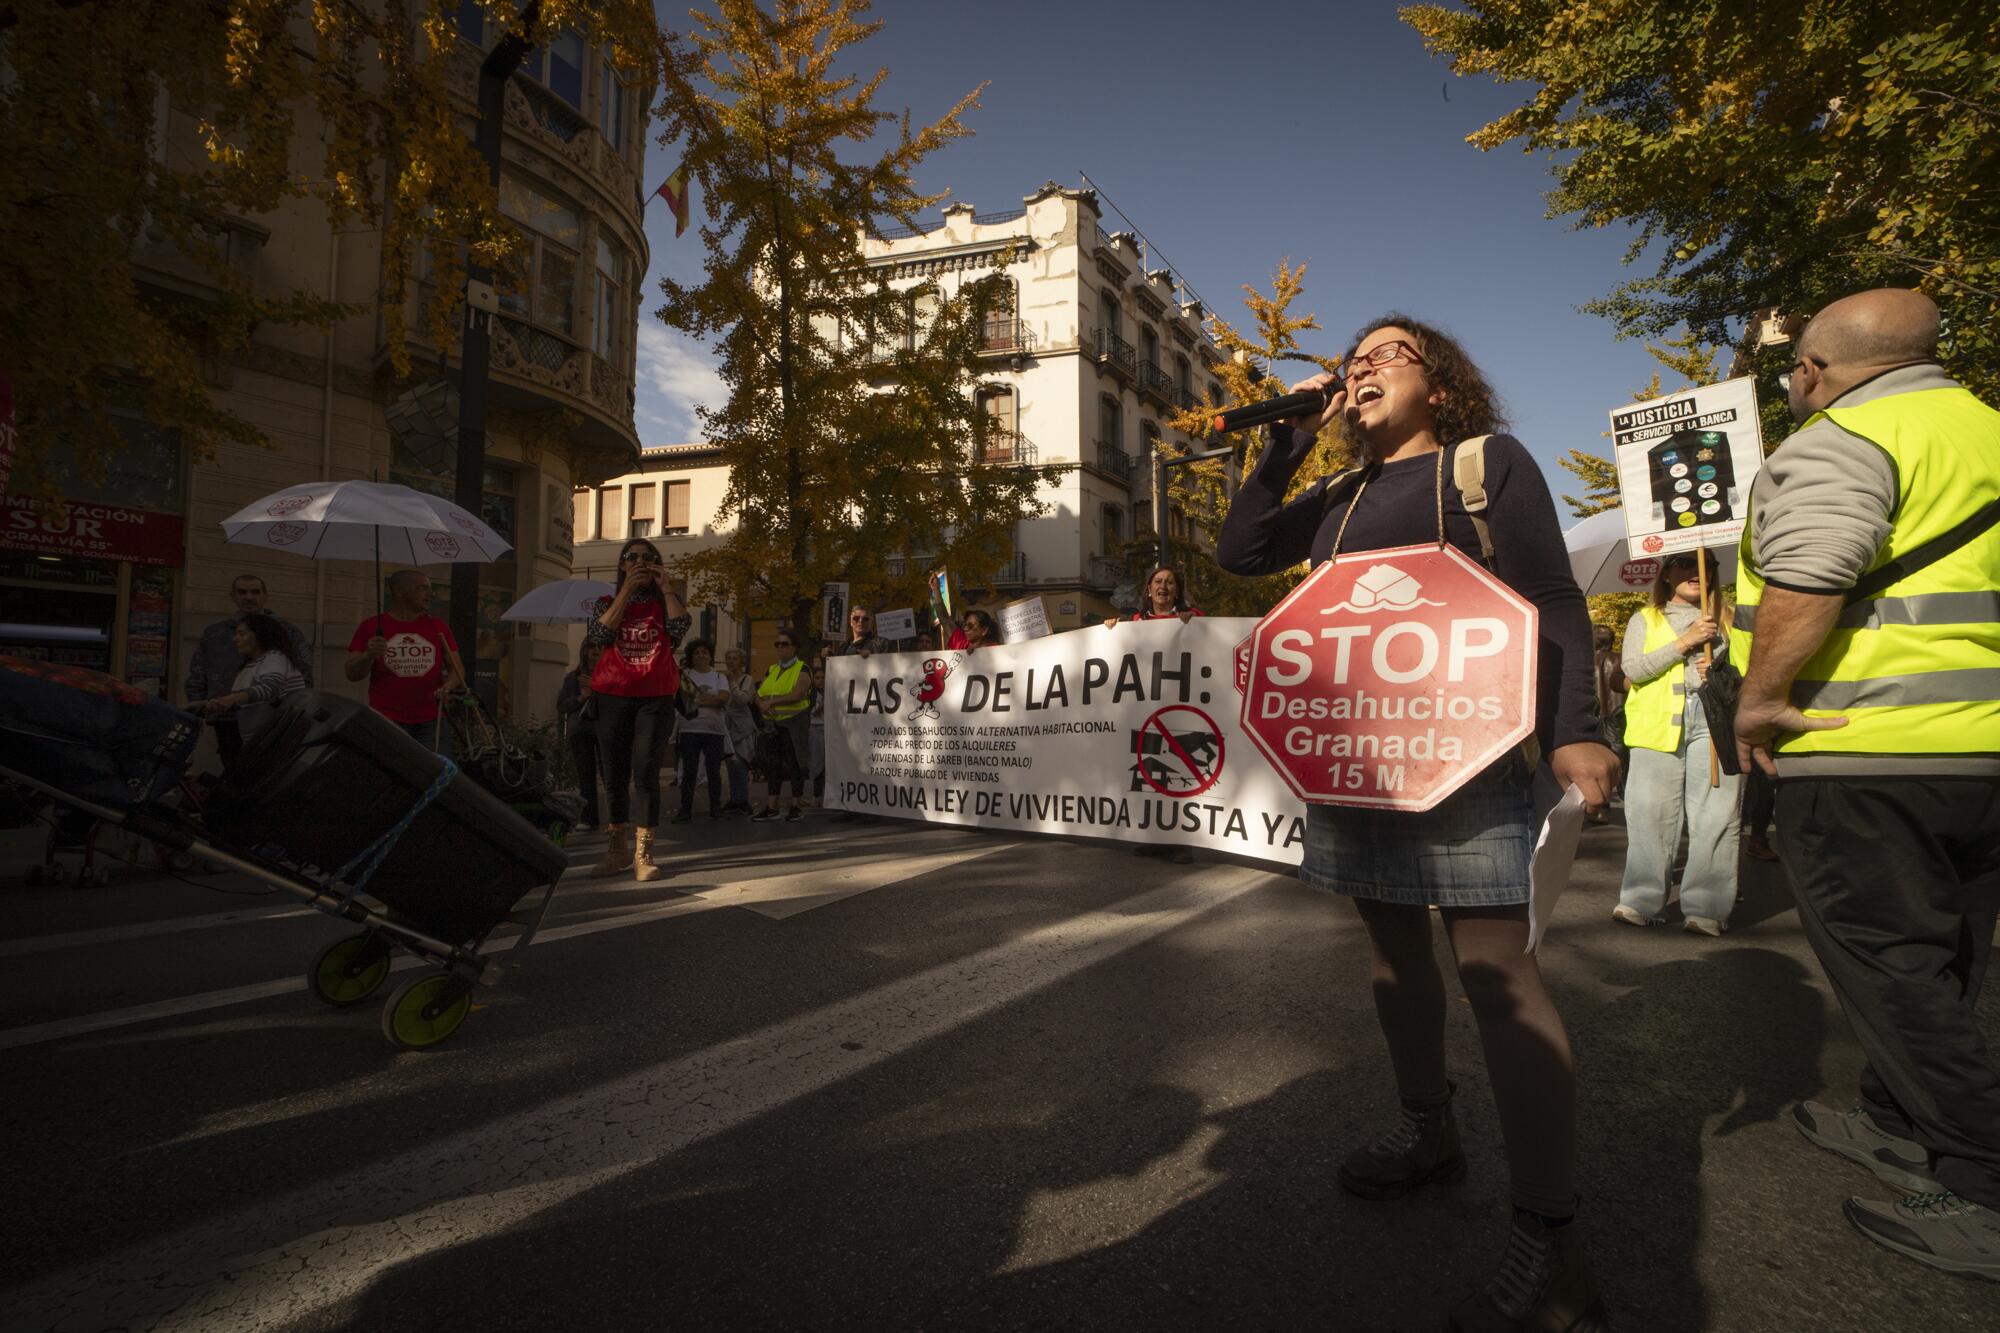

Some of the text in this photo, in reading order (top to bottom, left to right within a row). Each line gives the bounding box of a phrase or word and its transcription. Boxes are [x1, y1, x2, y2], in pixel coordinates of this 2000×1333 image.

[1619, 400, 1693, 427] LA JUSTICIA
[1622, 410, 1734, 444] AL SERVICIO DE LA BANCA
[9, 510, 104, 538] SUR
[58, 534, 86, 548] VÍA
[620, 628, 658, 642] STOP
[387, 646, 432, 658] STOP
[1266, 617, 1510, 686] STOP
[847, 678, 903, 714] LAS
[960, 671, 1014, 713] DE
[1026, 664, 1068, 710] LA
[1082, 652, 1212, 705] PAH:
[1261, 688, 1503, 721] Desahucios
[887, 726, 893, 736] A
[894, 726, 907, 736] LOS
[908, 726, 958, 736] DESAHUCIOS
[959, 726, 974, 736] SIN
[976, 725, 1041, 737] ALTERNATIVA
[1042, 721, 1116, 736] HABITACIONAL
[894, 740, 904, 749] AL
[905, 740, 932, 750] PRECIO
[933, 740, 944, 750] DE
[944, 740, 960, 750] LOS
[962, 740, 1016, 752] ALQUILERES
[1284, 726, 1463, 762] Granada
[870, 767, 999, 783] PARQUE PUBLICO DE VIVIENDAS
[914, 754, 924, 764] DE
[926, 754, 936, 764] LA
[936, 754, 962, 765] SAREB
[964, 754, 999, 767] (BANCO
[1001, 756, 1033, 770] MALO)
[1328, 762, 1405, 792] 15 M
[840, 782, 1305, 848] ¡POR UNA LEY DE VIVIENDA JUSTA YA
